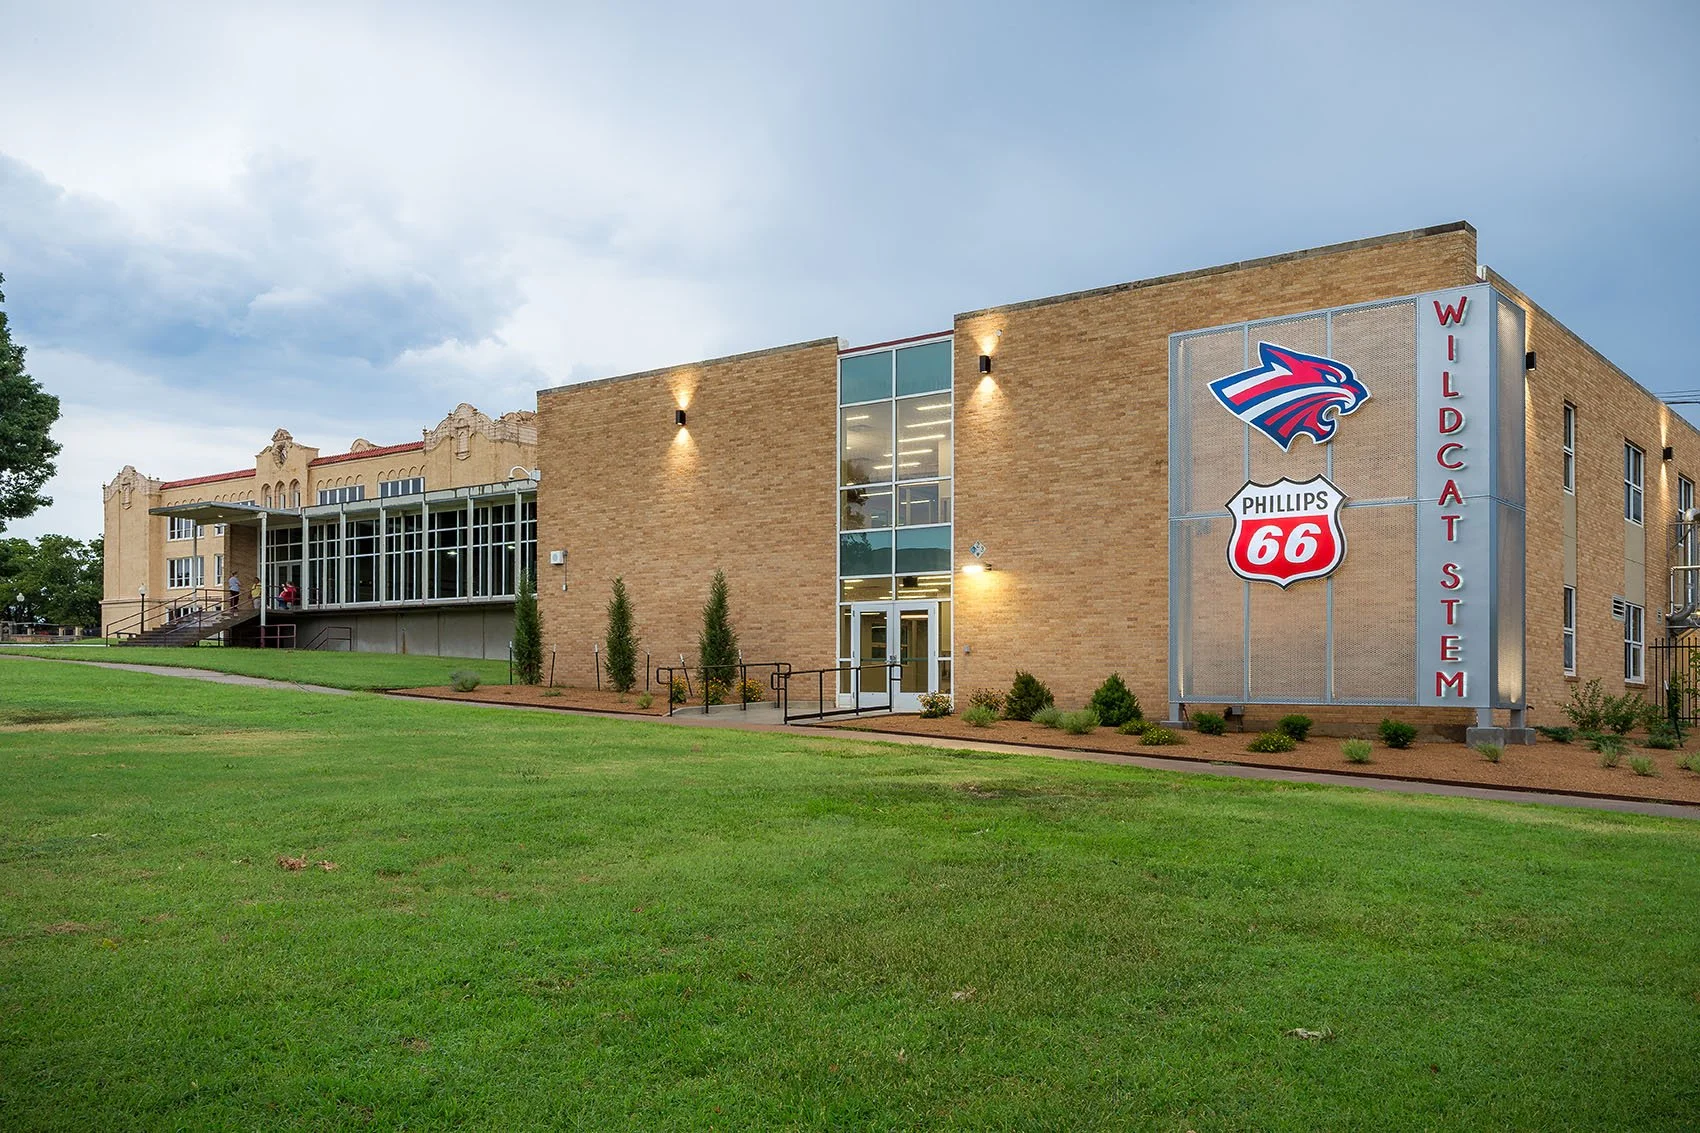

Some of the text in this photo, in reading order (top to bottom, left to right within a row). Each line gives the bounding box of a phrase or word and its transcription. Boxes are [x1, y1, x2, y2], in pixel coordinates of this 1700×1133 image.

[1242, 491, 1329, 515] PHILLIPS
[1432, 295, 1468, 698] WILDCAT STEM
[1247, 523, 1322, 565] 66
